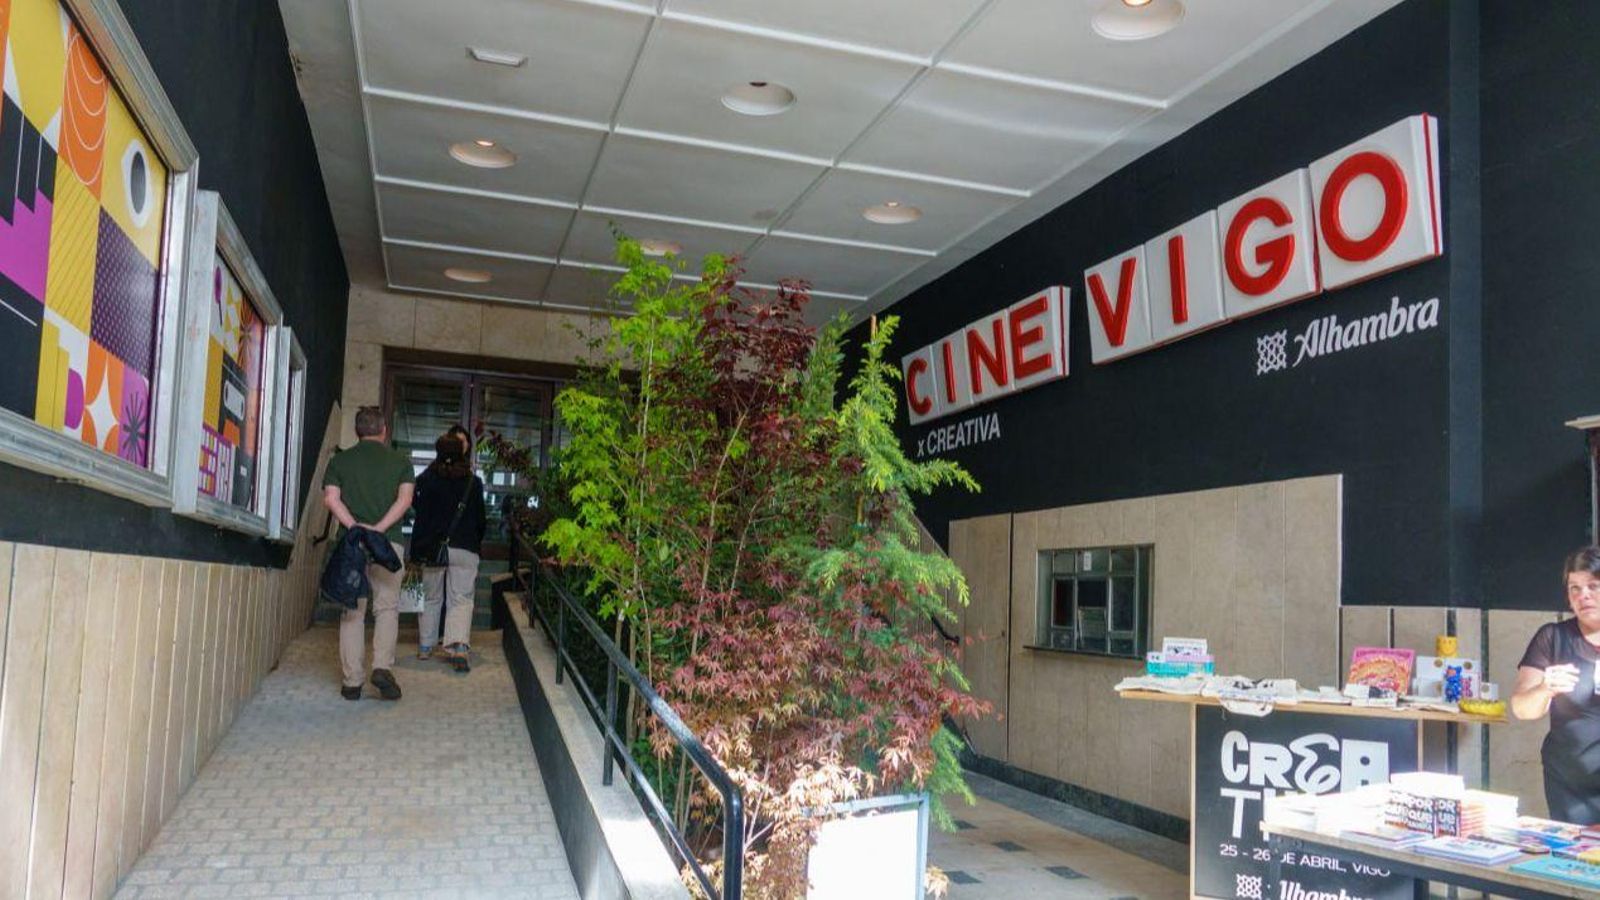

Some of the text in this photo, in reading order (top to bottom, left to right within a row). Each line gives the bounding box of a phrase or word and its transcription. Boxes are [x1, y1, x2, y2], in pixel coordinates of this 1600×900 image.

[905, 151, 1409, 416] CINE VIGO
[1292, 296, 1440, 367] Alhambra
[927, 412, 1000, 455] CREATIVA
[1219, 843, 1238, 857] 25
[1252, 848, 1271, 861] 26
